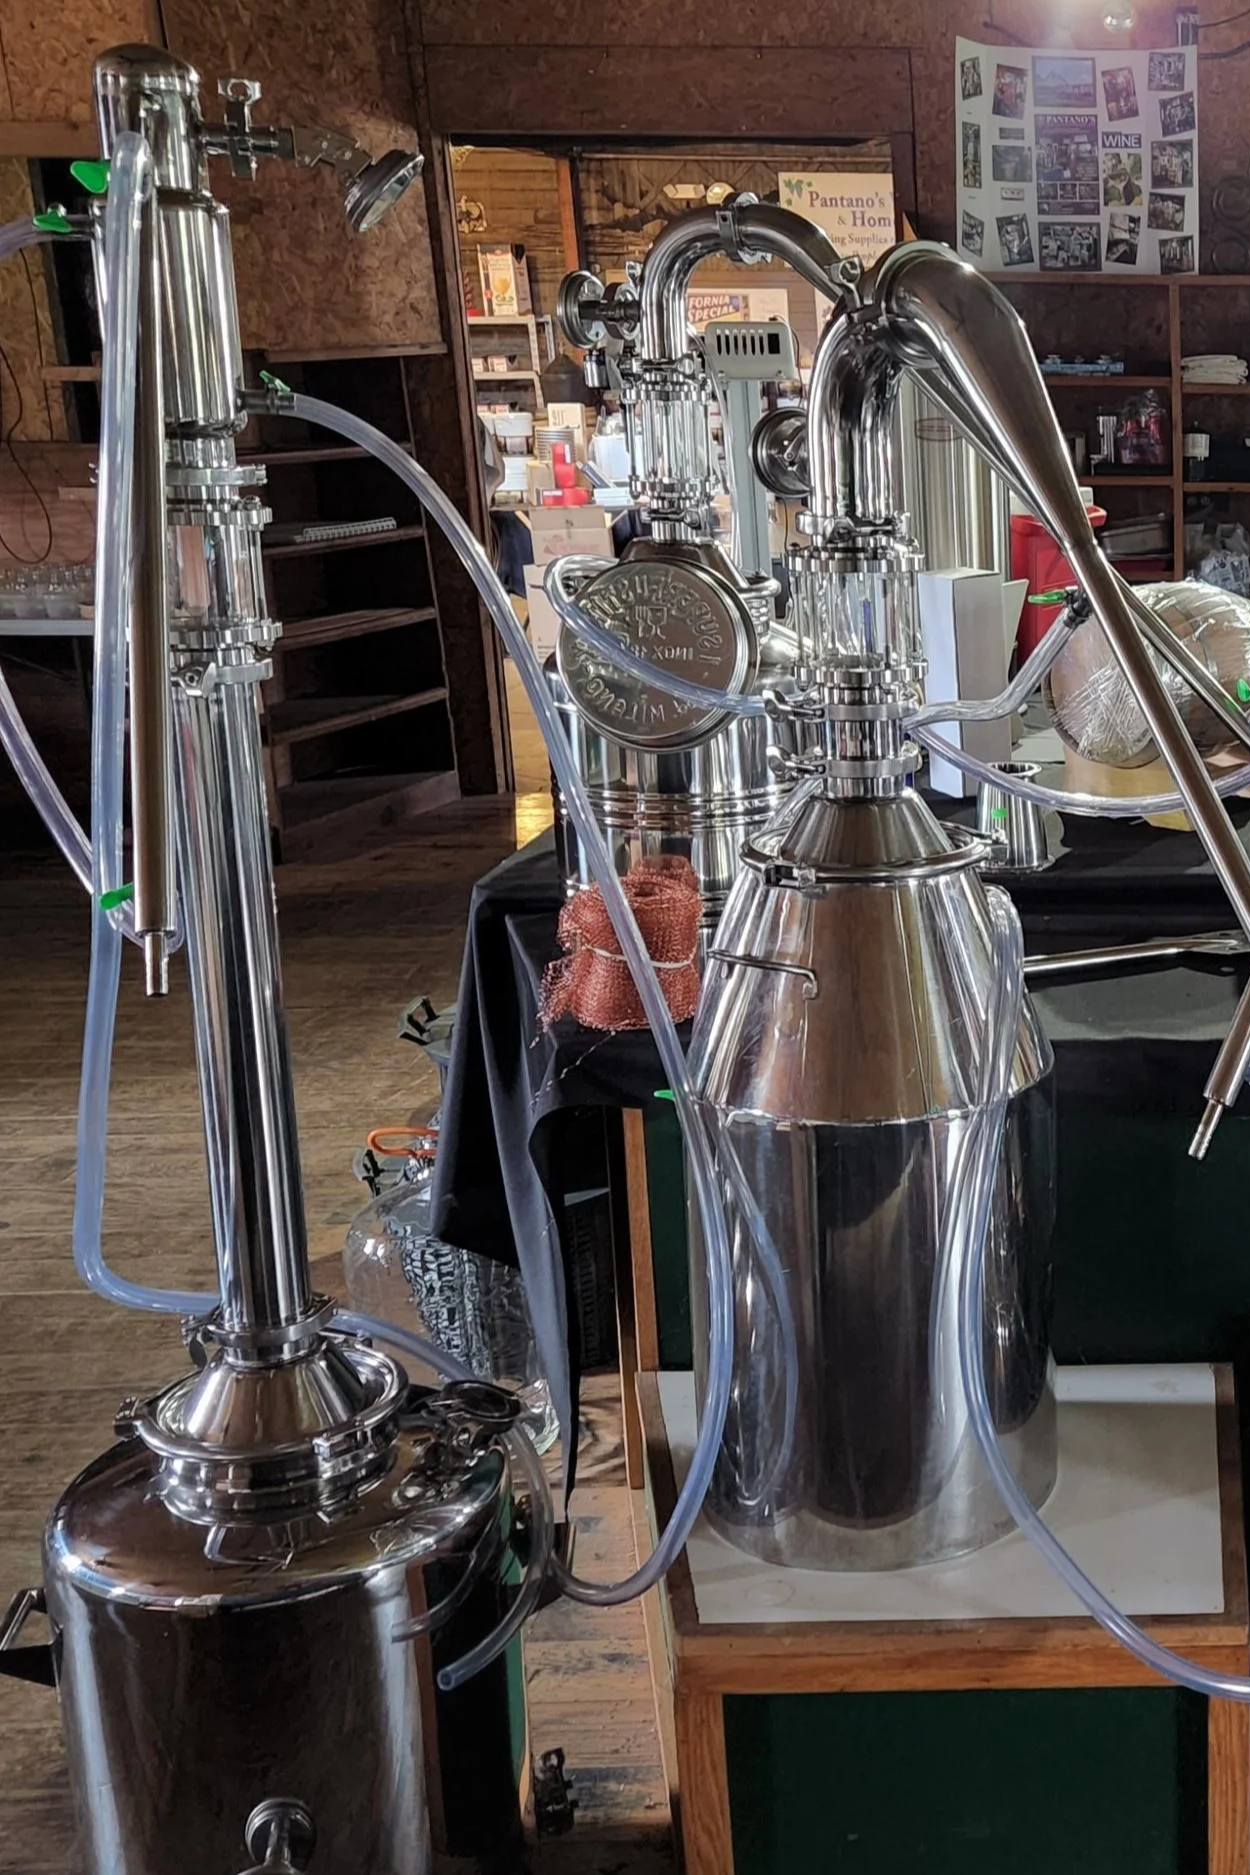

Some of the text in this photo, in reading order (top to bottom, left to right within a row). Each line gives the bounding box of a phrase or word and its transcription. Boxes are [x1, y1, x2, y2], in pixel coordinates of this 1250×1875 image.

[1103, 134, 1140, 148] WINE
[808, 190, 886, 209] Pantano's
[837, 210, 893, 228] & Hom
[687, 294, 731, 310] FORNIA
[687, 304, 736, 323] SPECIAL
